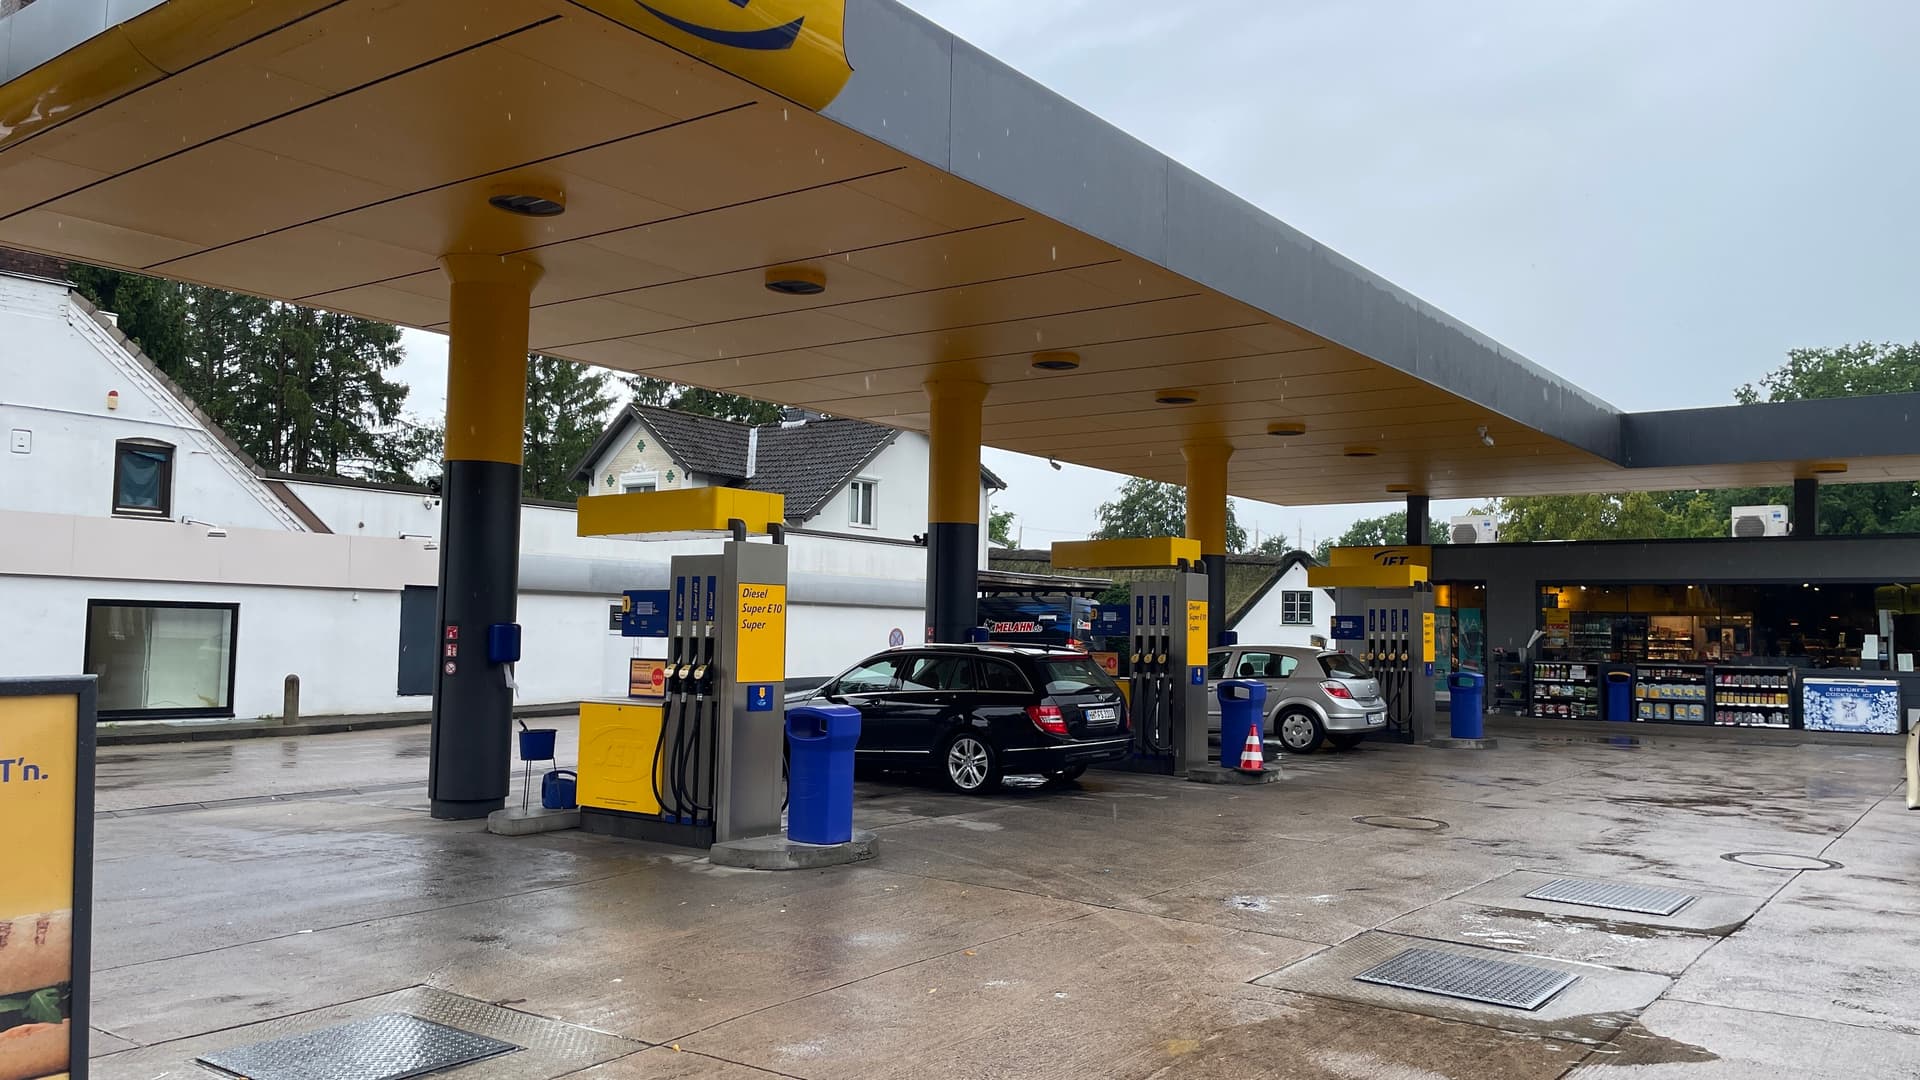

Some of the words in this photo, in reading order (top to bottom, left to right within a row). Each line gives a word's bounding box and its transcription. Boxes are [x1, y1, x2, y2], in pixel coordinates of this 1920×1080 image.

[742, 588, 768, 599] Diesel
[742, 603, 766, 616] Super
[767, 604, 782, 613] E10
[742, 619, 766, 632] Super
